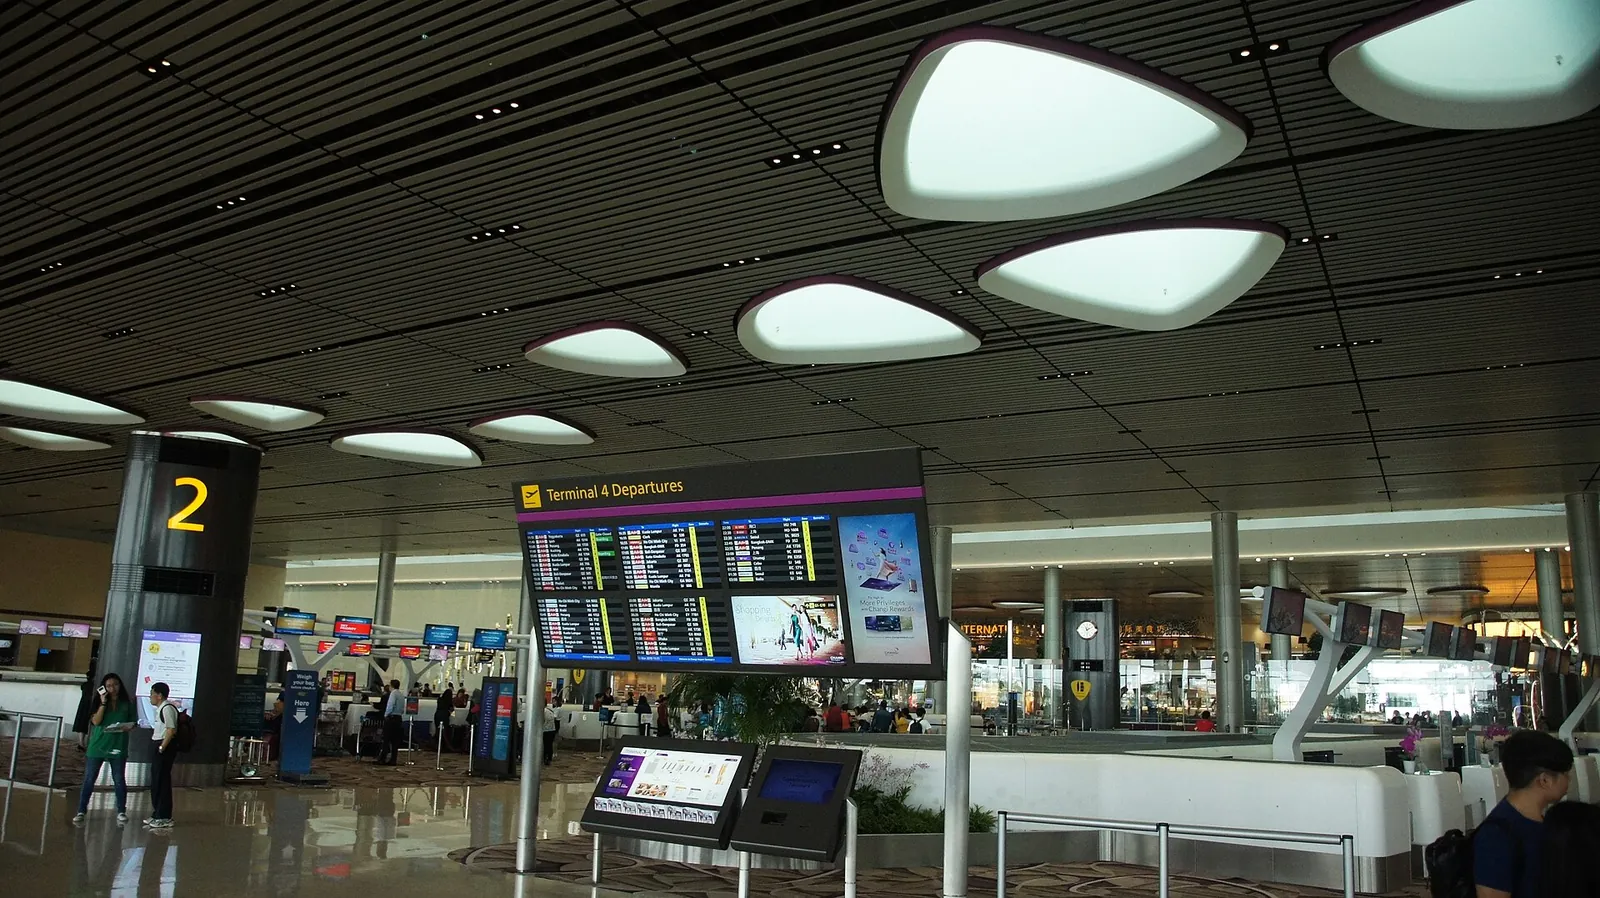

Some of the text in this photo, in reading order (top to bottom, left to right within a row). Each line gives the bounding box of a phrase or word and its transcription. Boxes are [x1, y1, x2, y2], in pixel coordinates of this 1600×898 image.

[168, 477, 207, 531] 2
[547, 480, 684, 501] Terminal 4 Departures
